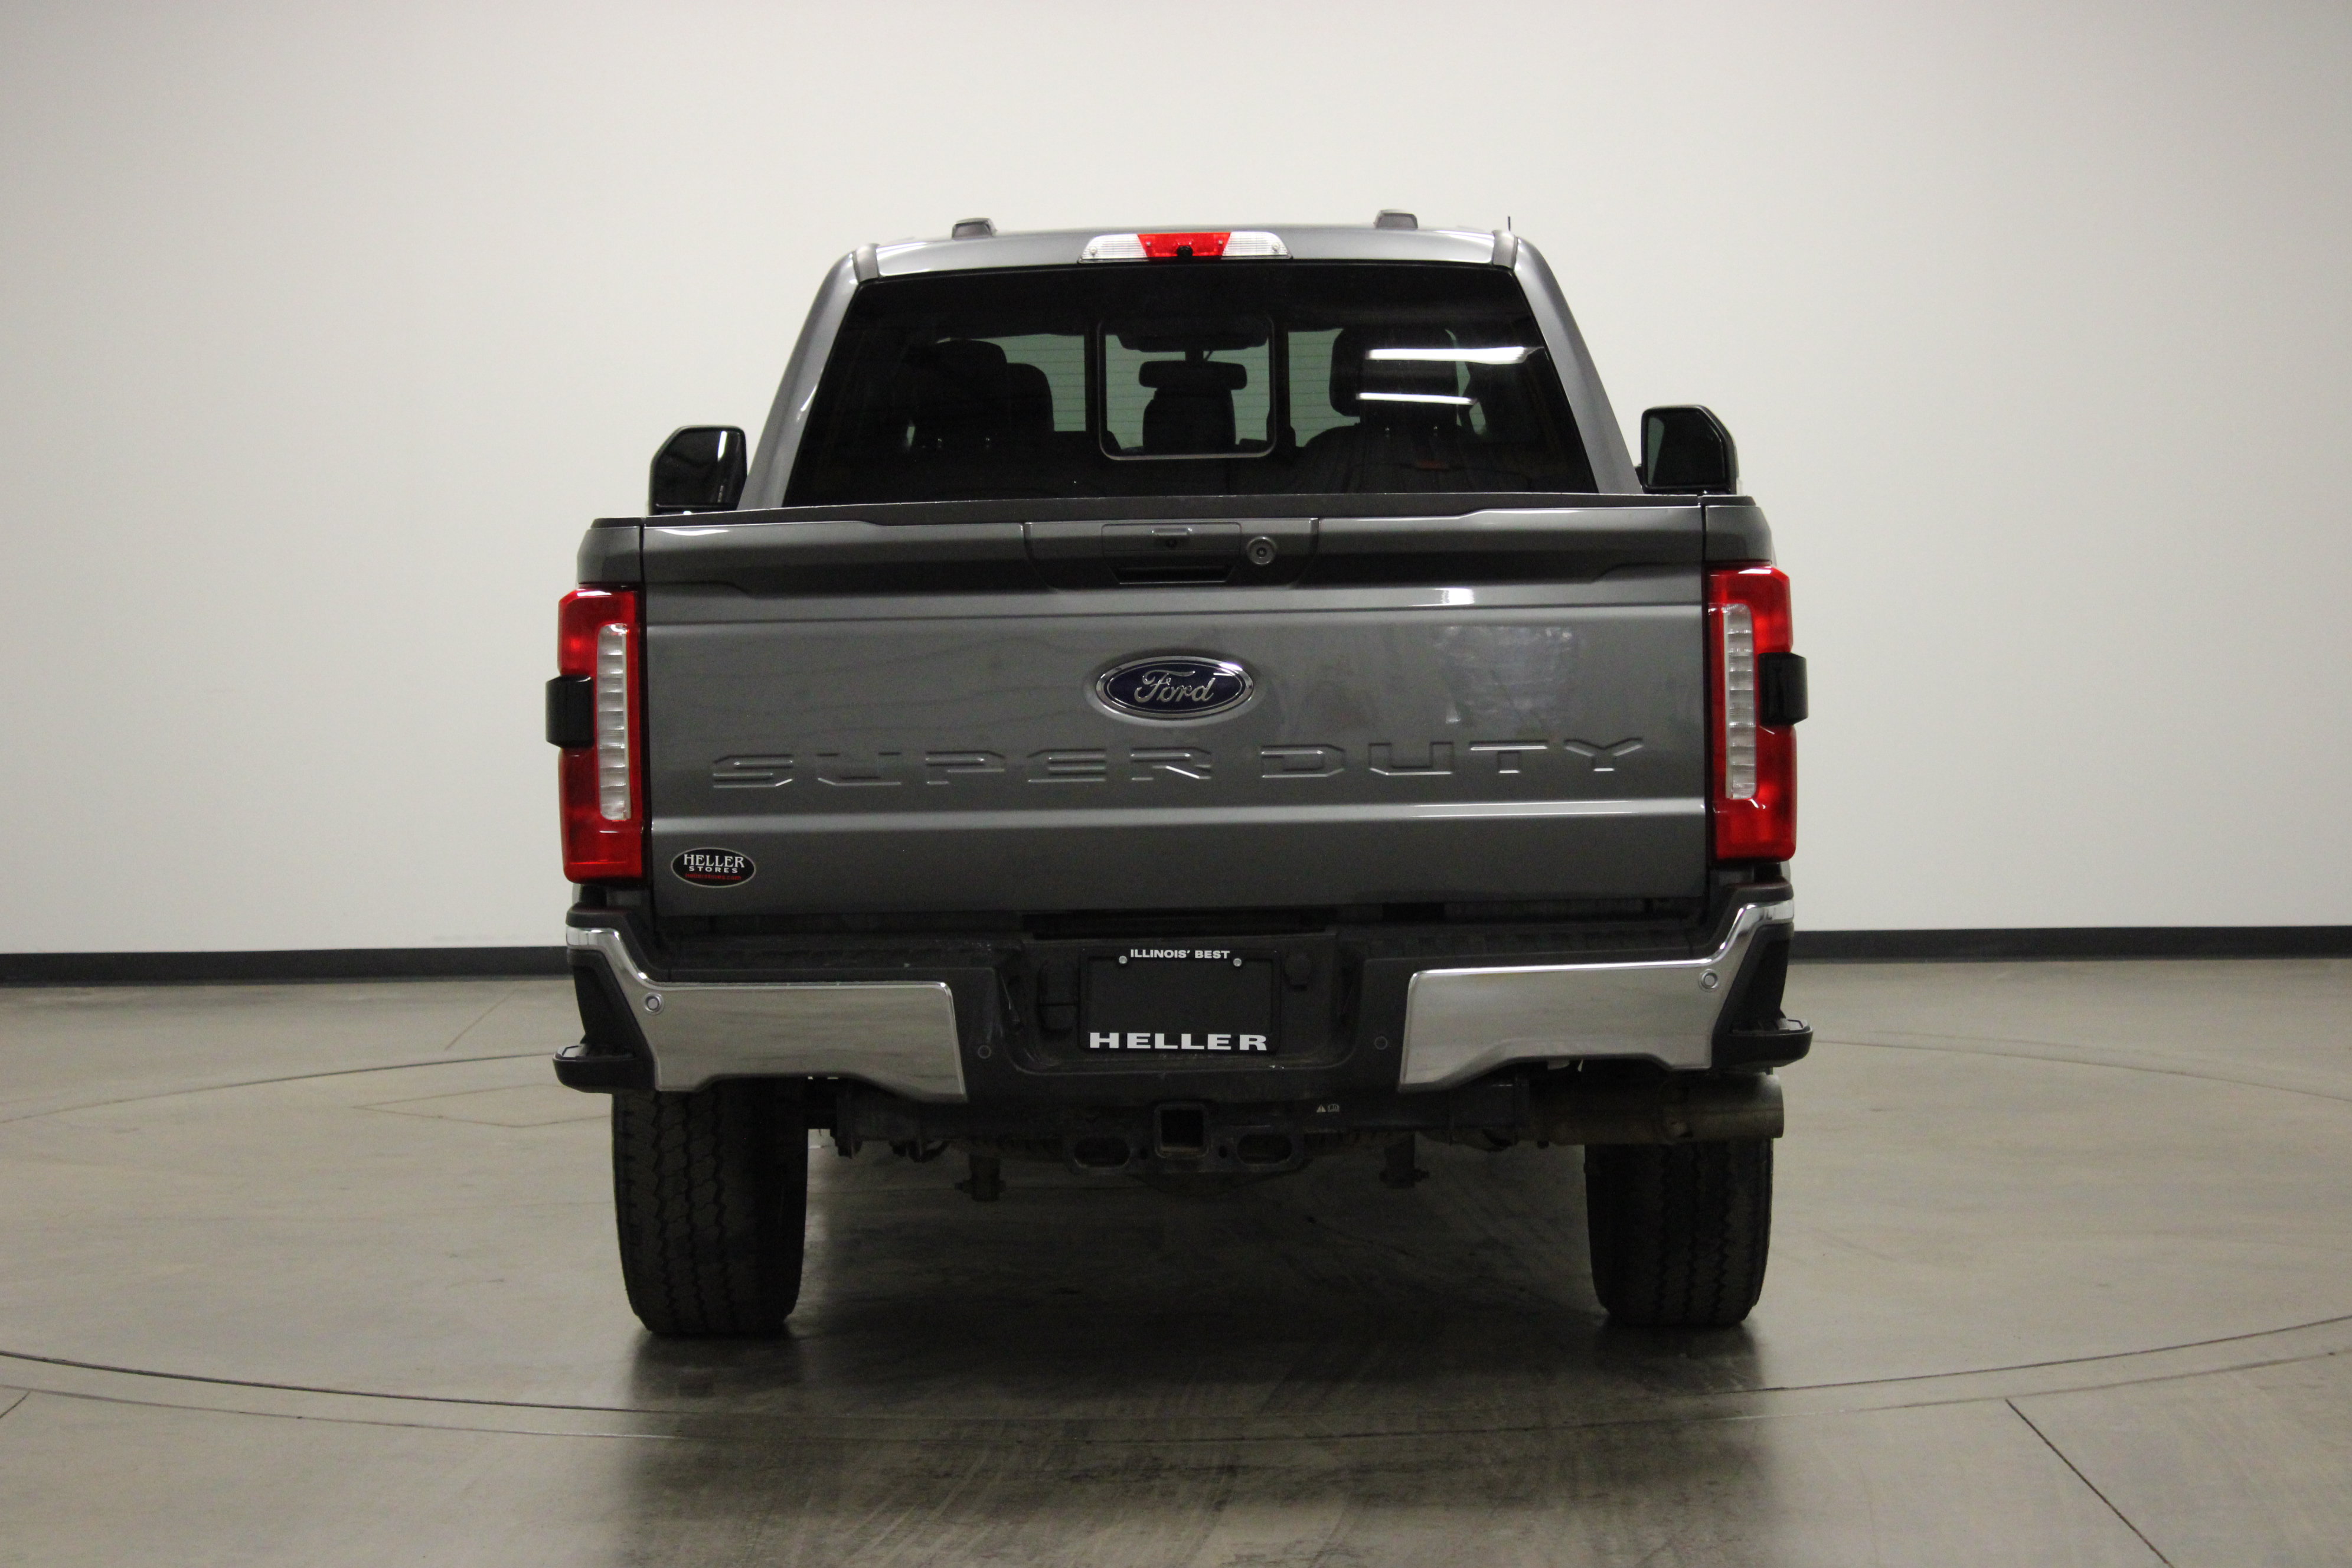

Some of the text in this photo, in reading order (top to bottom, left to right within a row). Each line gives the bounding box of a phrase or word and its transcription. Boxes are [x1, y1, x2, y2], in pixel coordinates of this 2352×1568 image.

[1134, 669, 1216, 703] Ford
[712, 737, 1644, 789] SUPER DUTY
[683, 854, 745, 868] HELLER
[1194, 950, 1230, 959] BEST
[1089, 1032, 1268, 1051] HELLER
